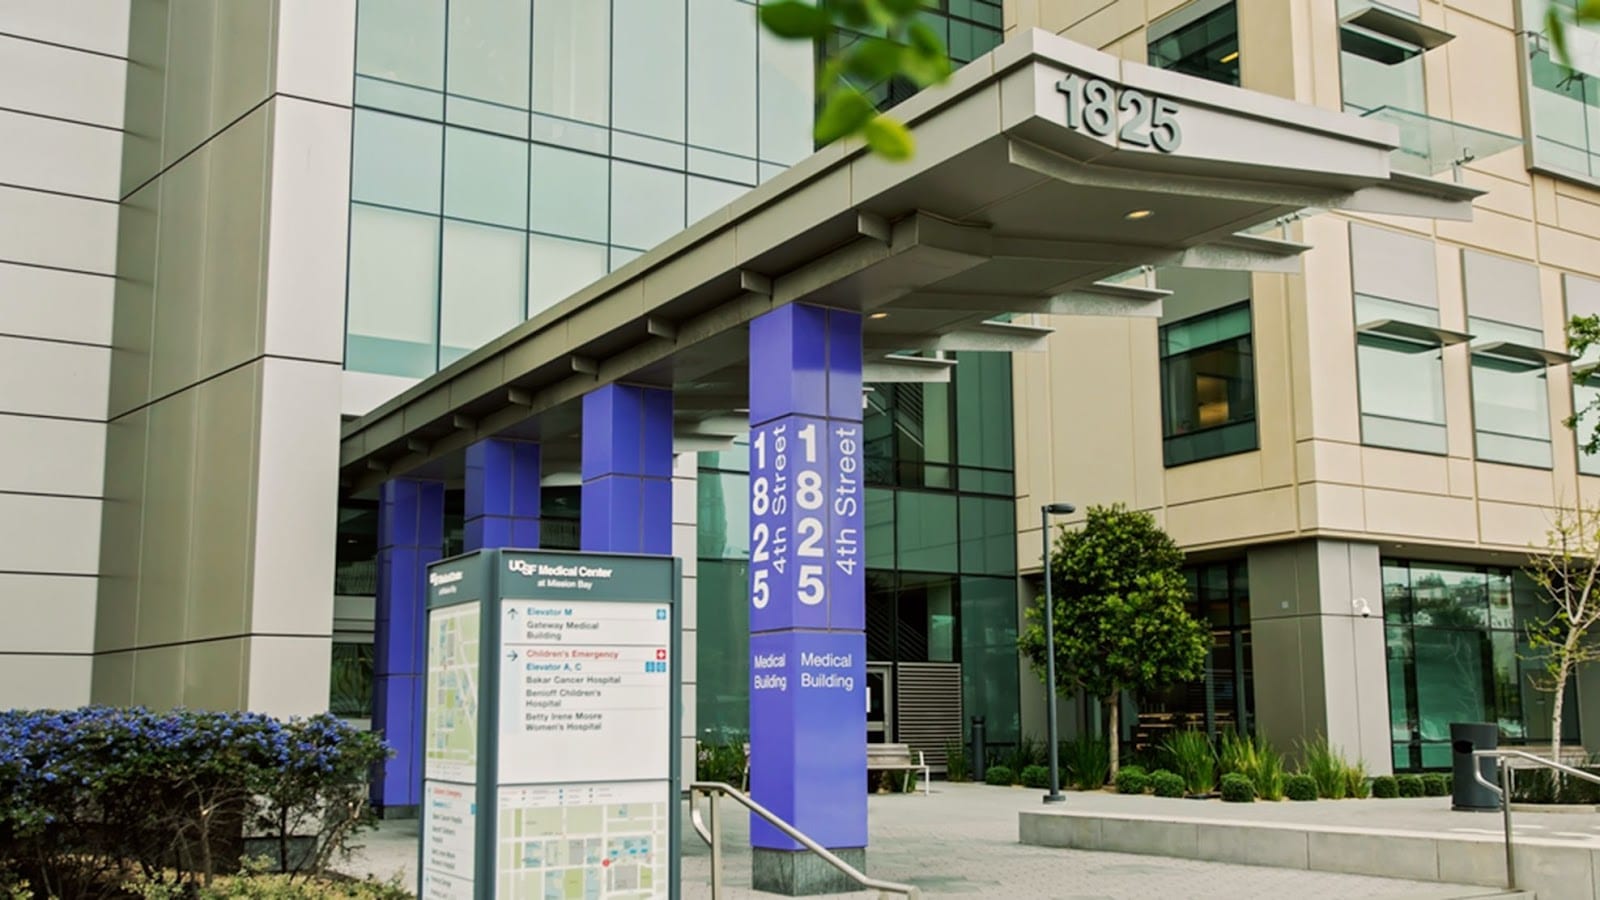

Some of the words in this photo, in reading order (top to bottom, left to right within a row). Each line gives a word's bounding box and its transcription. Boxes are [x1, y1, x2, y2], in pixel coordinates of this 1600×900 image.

[1056, 73, 1182, 153] 1825
[771, 424, 787, 515] Street
[834, 427, 857, 517] Street
[752, 431, 769, 609] 1825
[796, 424, 825, 605] 1825
[772, 526, 787, 574] 4th
[835, 527, 857, 575] 4th
[508, 559, 537, 576] UCSF
[538, 564, 578, 577] Medical
[578, 566, 613, 578] Center
[537, 579, 546, 587] at
[546, 579, 577, 588] Mission
[577, 580, 593, 591] Bay
[526, 607, 562, 616] Elevator
[564, 608, 573, 616] M
[526, 621, 563, 630] Gateway
[566, 621, 599, 630] Medical
[526, 631, 562, 641] Building
[526, 649, 569, 658] Children's
[572, 650, 619, 659] Emergency
[754, 653, 786, 669] Medical
[801, 652, 852, 668] Medical
[526, 663, 561, 671] Elevator
[563, 663, 572, 672] A,
[575, 663, 582, 671] C
[526, 676, 551, 684] Bakar
[554, 676, 584, 684] Cancer
[586, 676, 621, 685] Hospital
[754, 674, 787, 691] Building
[801, 672, 854, 691] Building
[526, 689, 557, 697] Benioff
[559, 689, 602, 697] Children's
[526, 700, 562, 708] Hospital
[526, 713, 549, 721] Betty
[566, 723, 602, 732] Hospital
